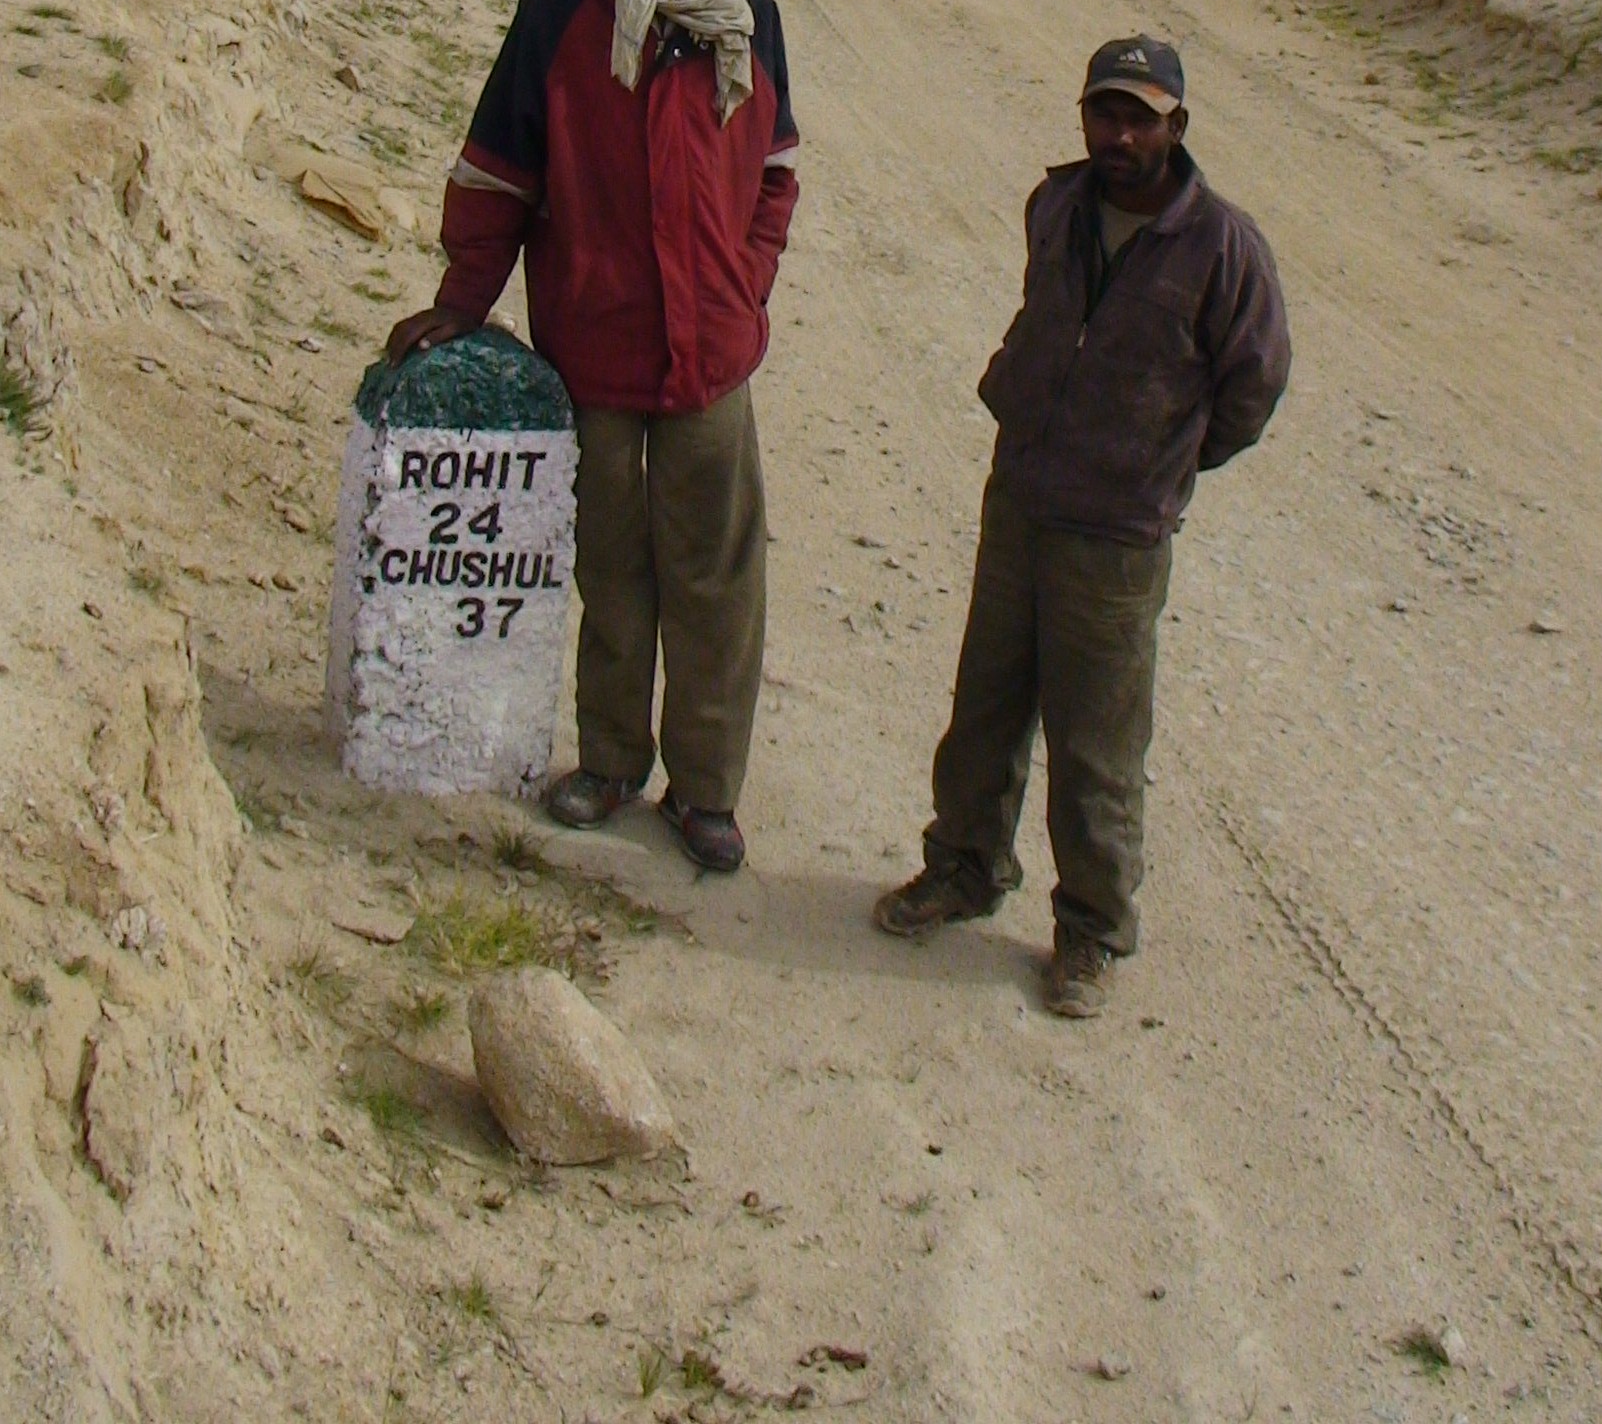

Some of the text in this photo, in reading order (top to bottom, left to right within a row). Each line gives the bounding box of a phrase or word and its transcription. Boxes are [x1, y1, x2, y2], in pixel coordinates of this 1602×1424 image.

[400, 451, 546, 490] ROHIT
[429, 502, 503, 544] 24
[380, 549, 562, 588] CHUSHUL
[456, 597, 524, 638] 37
